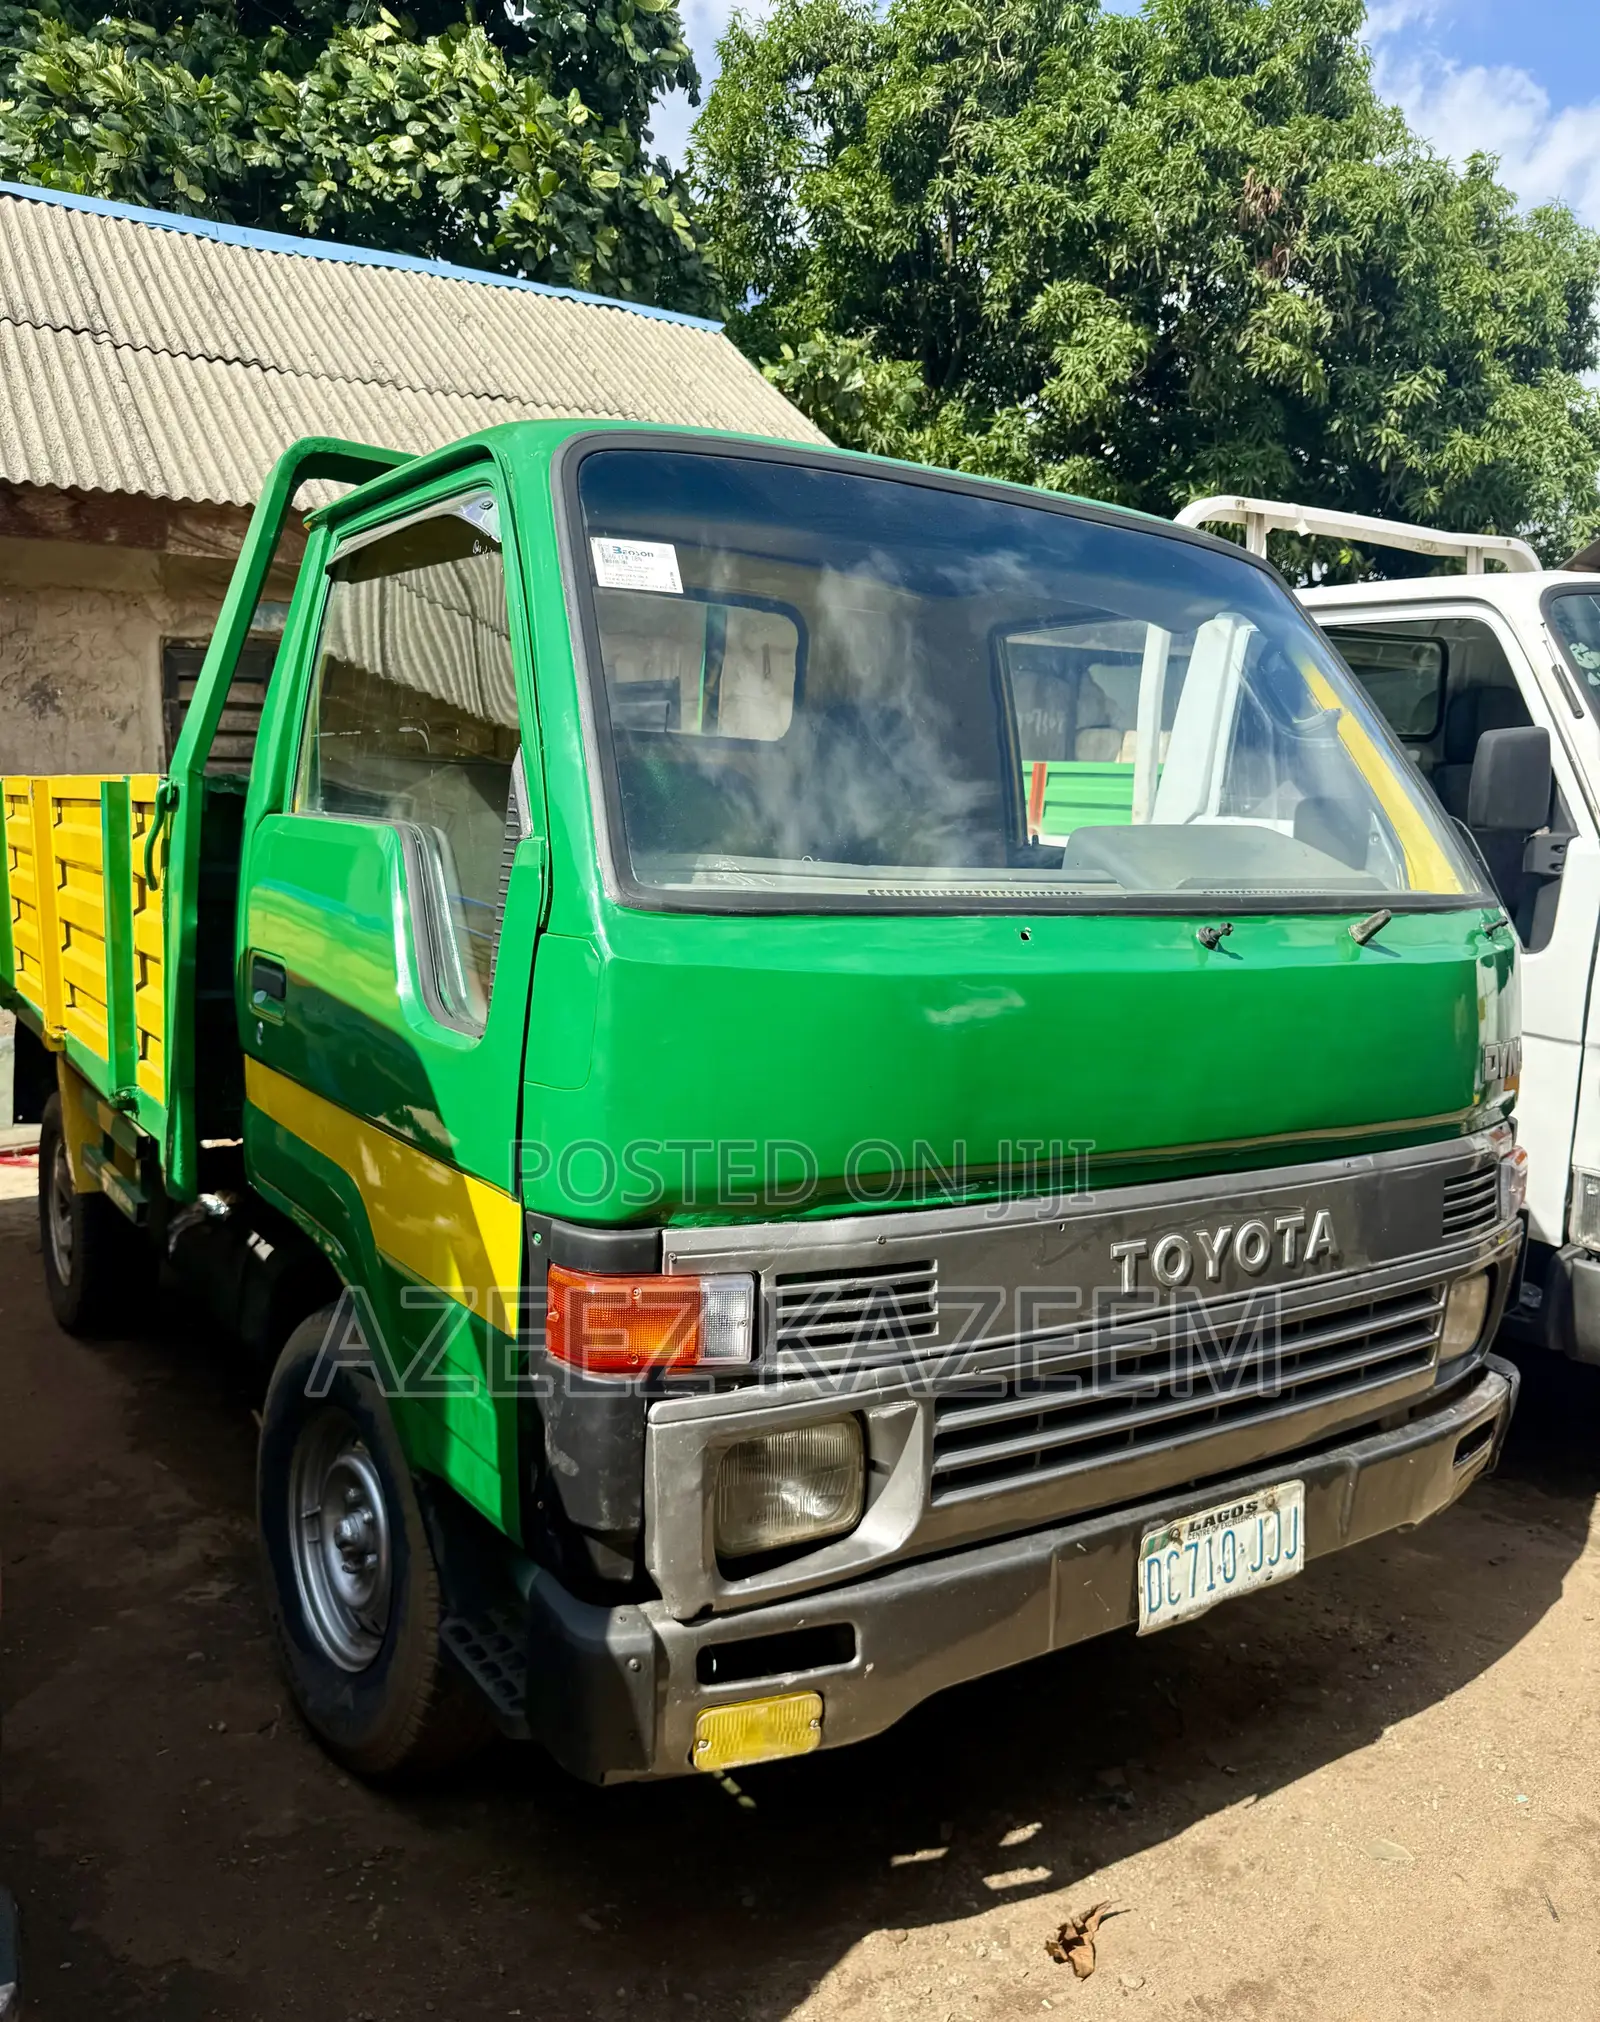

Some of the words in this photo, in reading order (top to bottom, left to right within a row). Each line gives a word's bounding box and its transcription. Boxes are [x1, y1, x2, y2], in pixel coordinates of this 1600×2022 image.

[1110, 1209, 1340, 1296] TOYOTA
[1187, 1527, 1211, 1541] CENTRE
[1220, 1512, 1257, 1530] EXCELLENCE
[1188, 1500, 1259, 1533] LAGOS
